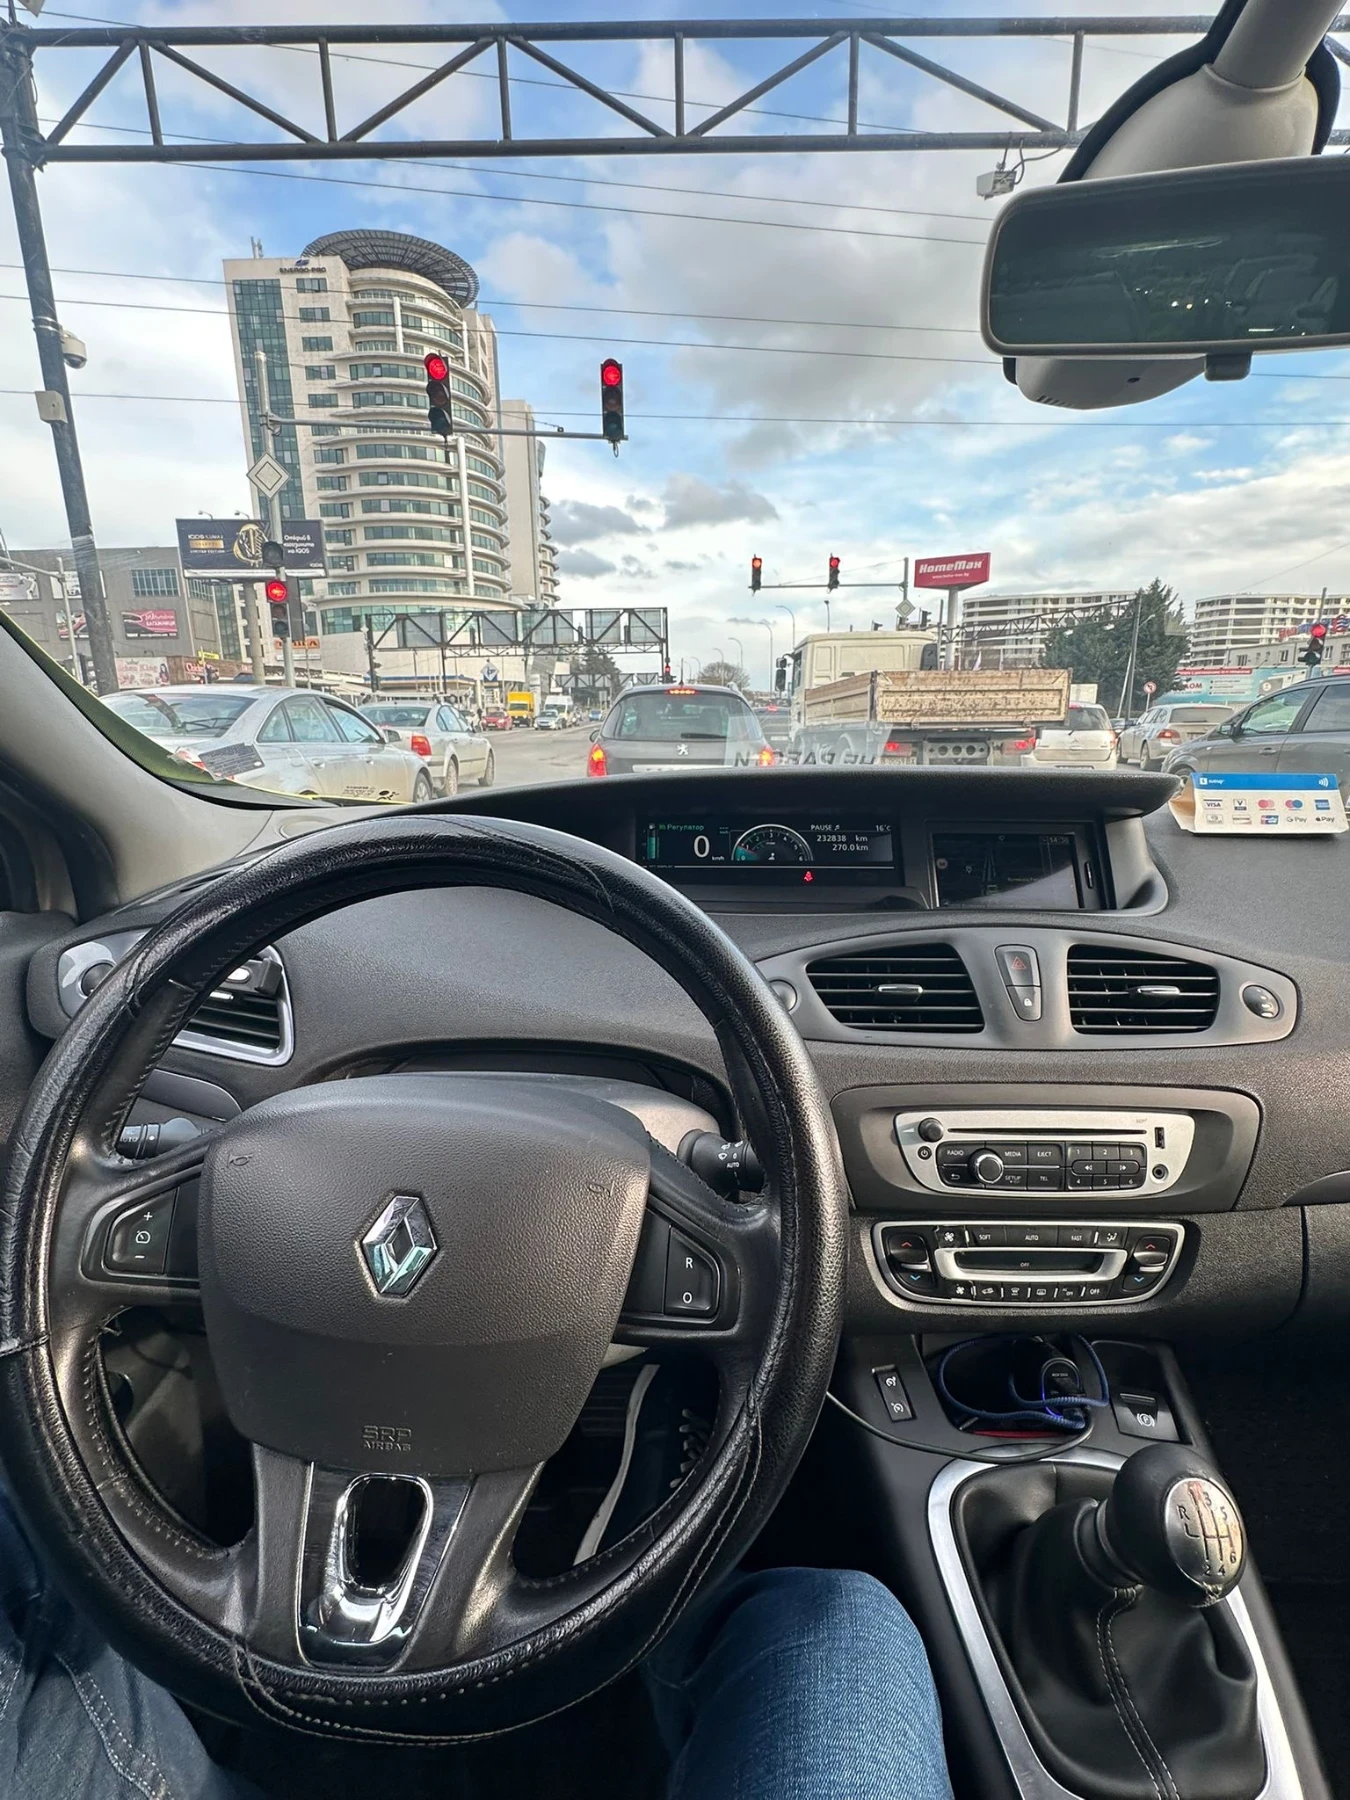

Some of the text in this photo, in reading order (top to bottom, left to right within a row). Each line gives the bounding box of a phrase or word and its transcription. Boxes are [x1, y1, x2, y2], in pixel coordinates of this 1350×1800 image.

[694, 835, 710, 858] 0
[686, 1258, 693, 1269] R
[363, 1425, 411, 1442] SRP
[364, 1440, 411, 1451] AIRBAG
[1177, 1505, 1190, 1520] R
[1230, 1552, 1237, 1564] 6
[1203, 1565, 1212, 1576] 2
